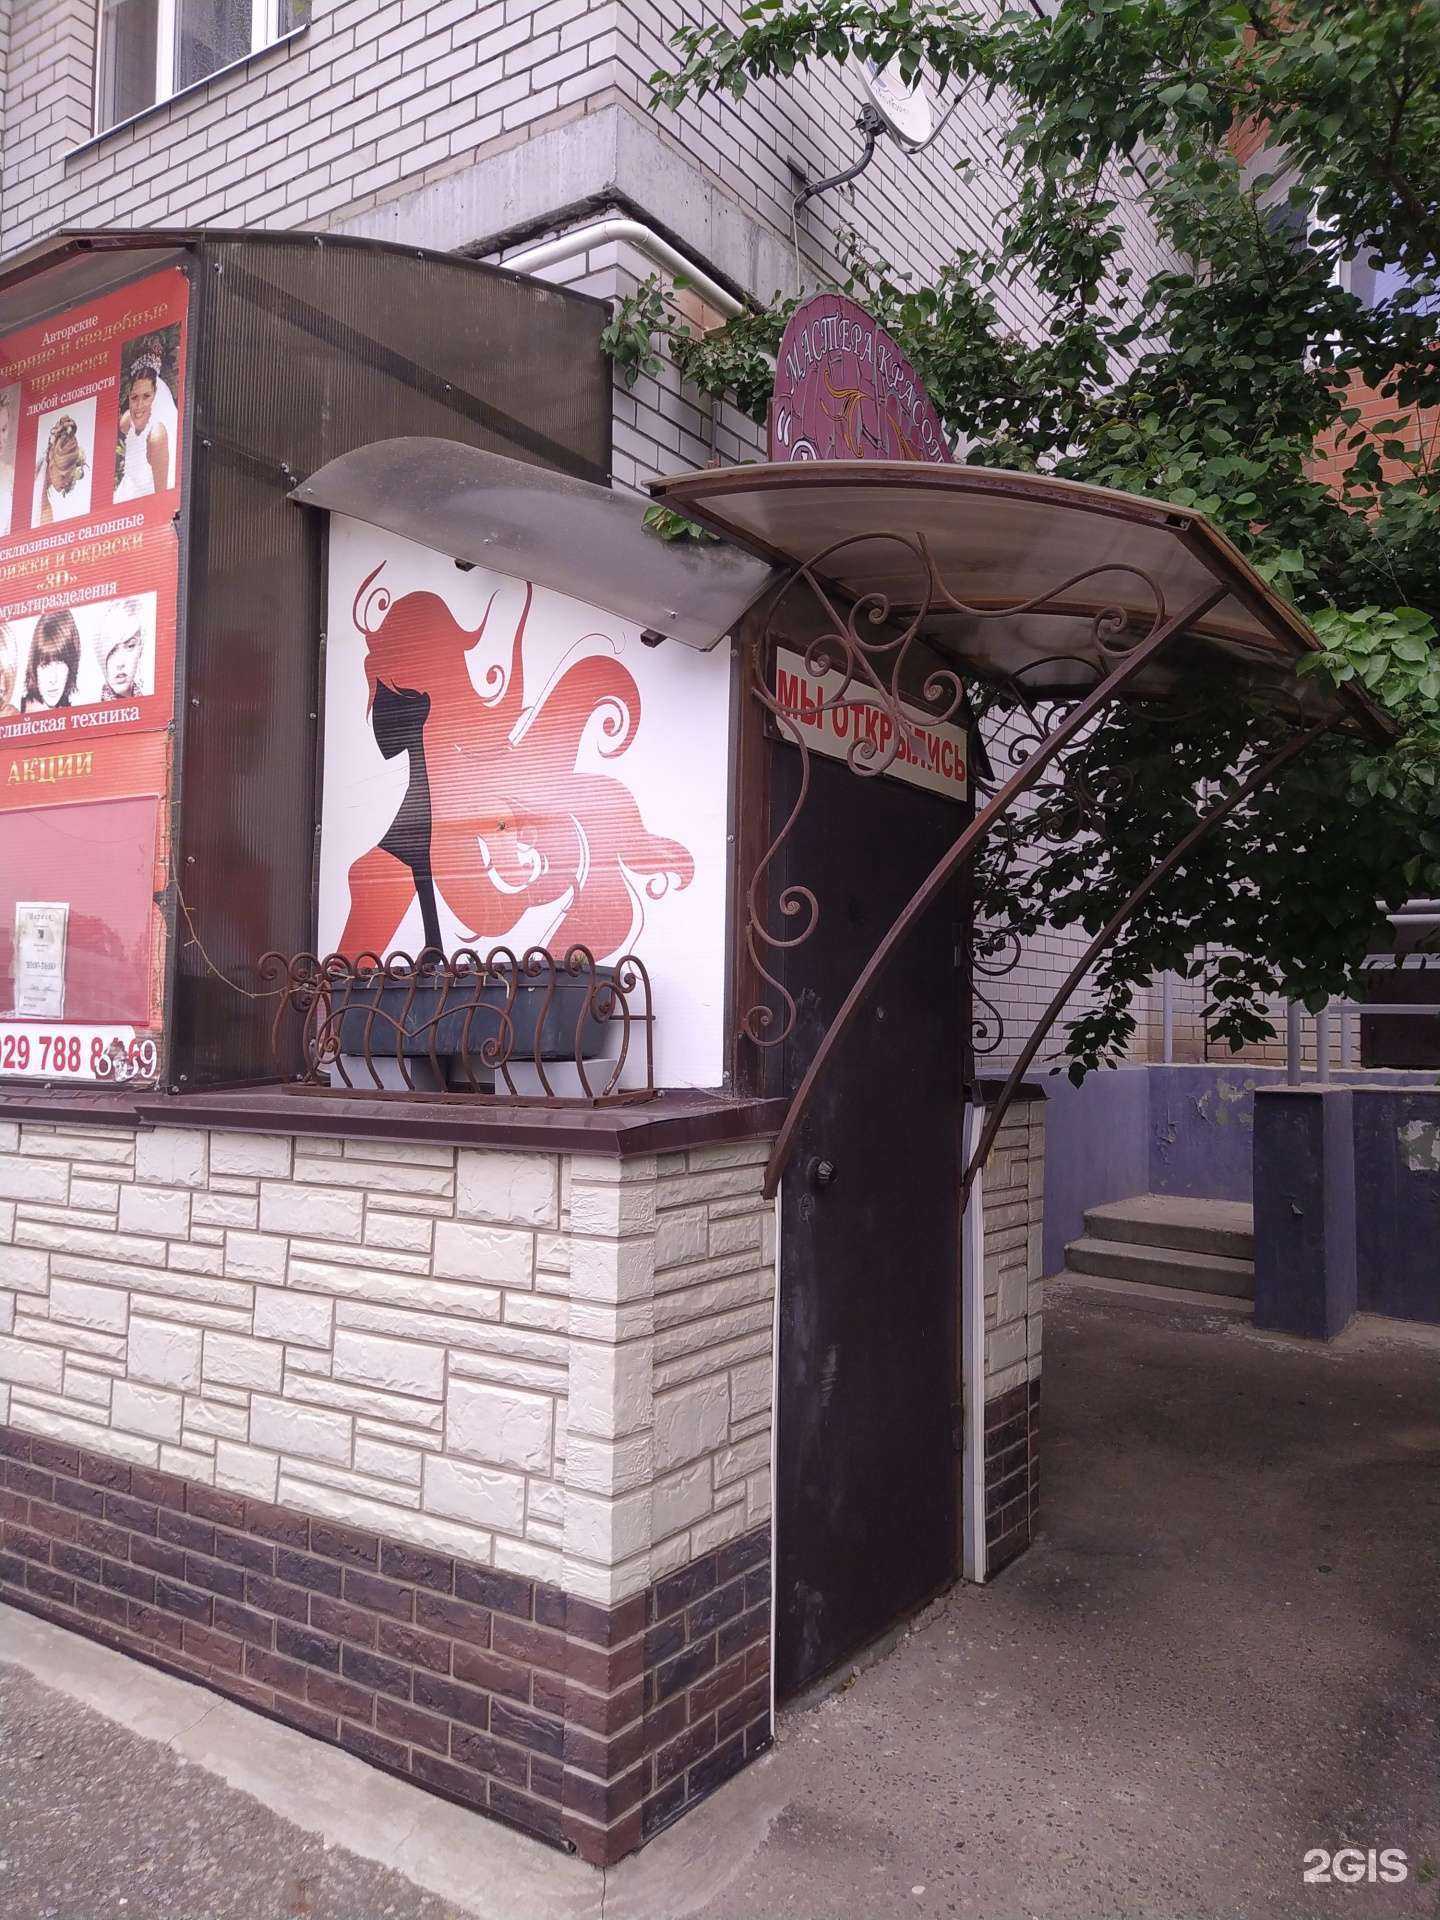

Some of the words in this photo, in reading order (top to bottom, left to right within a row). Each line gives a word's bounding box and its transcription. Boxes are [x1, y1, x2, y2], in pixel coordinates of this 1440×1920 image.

[41, 315, 98, 346] Авторские
[75, 302, 168, 350] свадебные
[32, 351, 109, 393] прически
[785, 313, 875, 395] МАСТЕРА
[28, 394, 58, 416] любой
[60, 376, 116, 404] сложности
[78, 513, 144, 540] салонные
[70, 532, 144, 565] окраски
[70, 706, 140, 729] техника
[778, 669, 824, 730] МЫ
[7, 752, 94, 784] АКЦИИ
[0, 1035, 30, 1070] 29
[39, 1036, 81, 1072] 788
